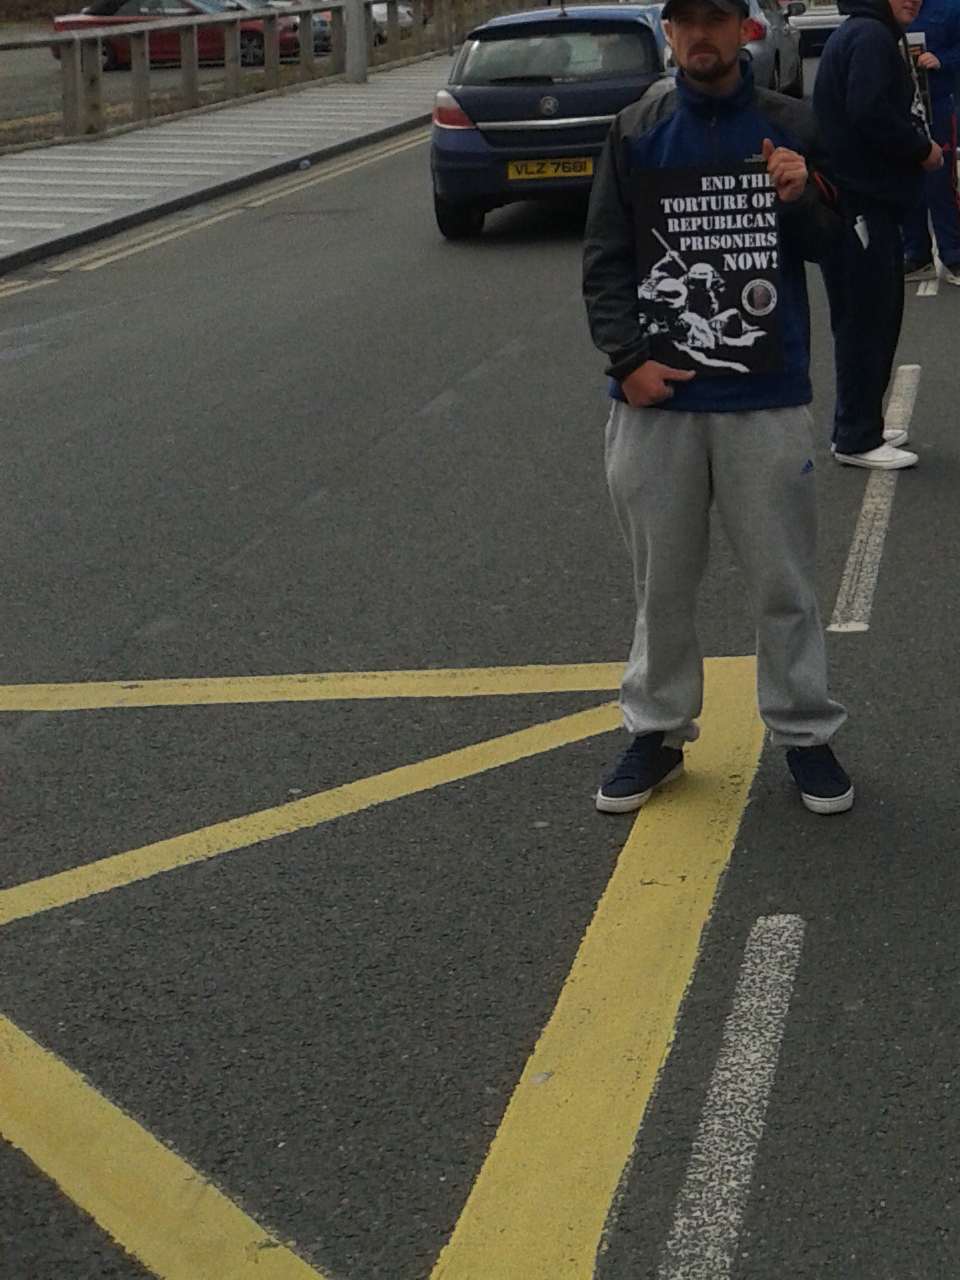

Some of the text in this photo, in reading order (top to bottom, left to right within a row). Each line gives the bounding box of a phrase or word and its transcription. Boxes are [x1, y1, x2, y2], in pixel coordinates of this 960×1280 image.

[513, 162, 547, 176] VLZ
[701, 174, 735, 192] END
[660, 191, 777, 214] TORTURE OF
[667, 212, 777, 233] REPUBLICAN
[680, 231, 778, 252] PRISONERS
[723, 250, 779, 271] NOW!
